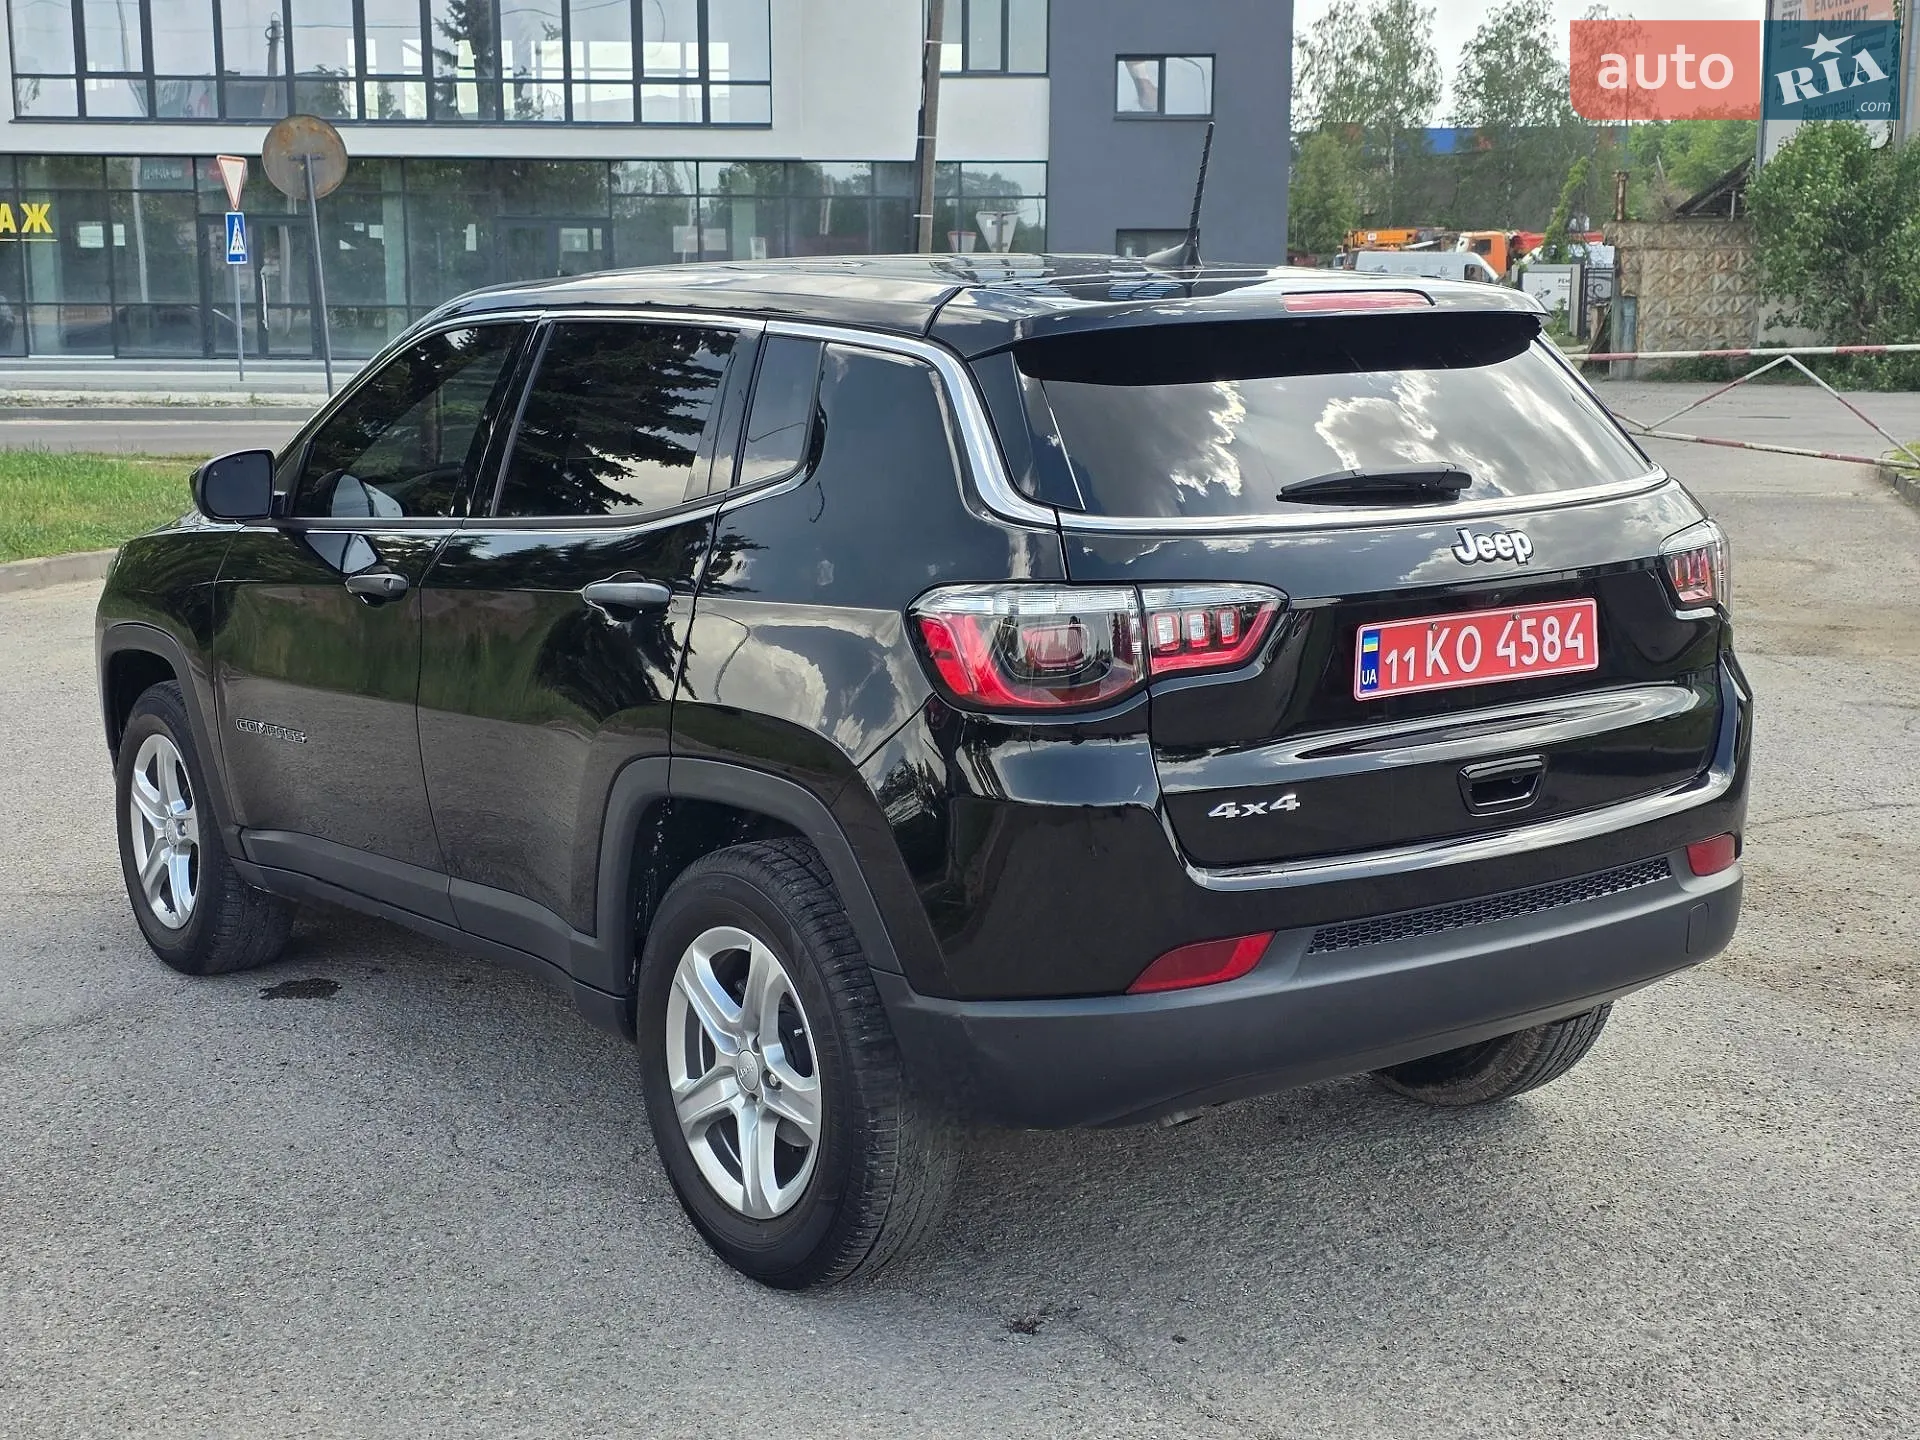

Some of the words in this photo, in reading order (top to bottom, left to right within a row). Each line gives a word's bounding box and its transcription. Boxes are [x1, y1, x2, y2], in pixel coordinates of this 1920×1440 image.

[1451, 528, 1535, 565] Jeep
[1495, 612, 1584, 669] 4584
[1362, 668, 1377, 685] UA
[236, 718, 307, 743] COMPASS
[1208, 793, 1300, 819] 4x4
